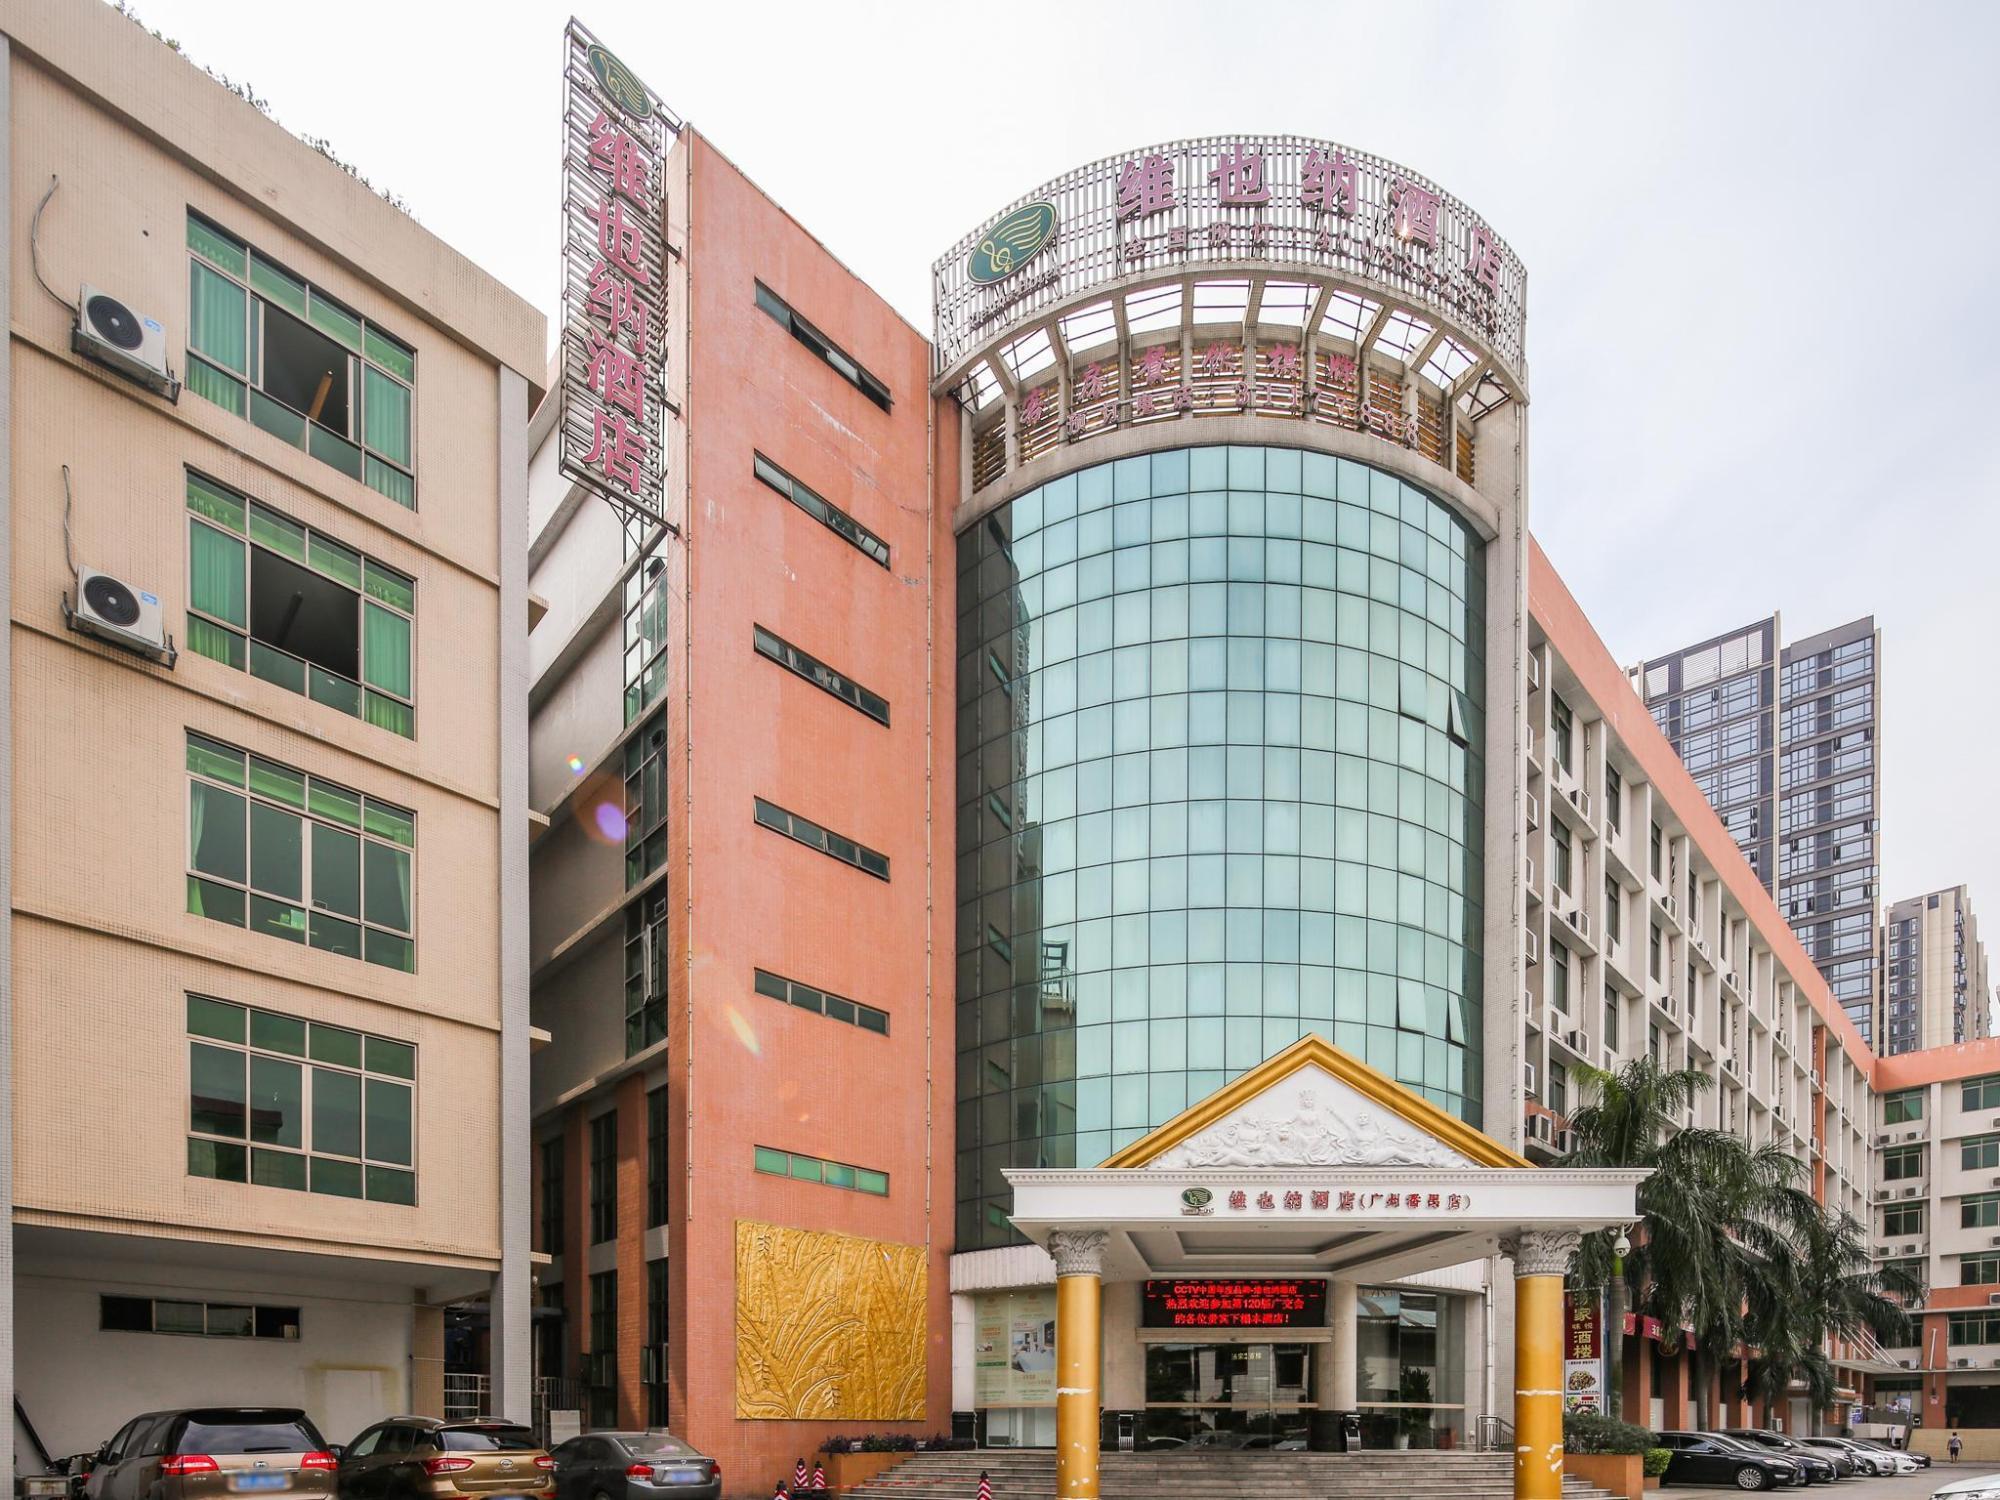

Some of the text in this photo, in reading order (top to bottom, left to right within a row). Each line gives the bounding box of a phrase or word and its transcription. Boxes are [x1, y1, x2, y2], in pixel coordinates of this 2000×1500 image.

[583, 110, 651, 494] 维也纳酒店
[1117, 143, 1504, 300] 维也纳酒店
